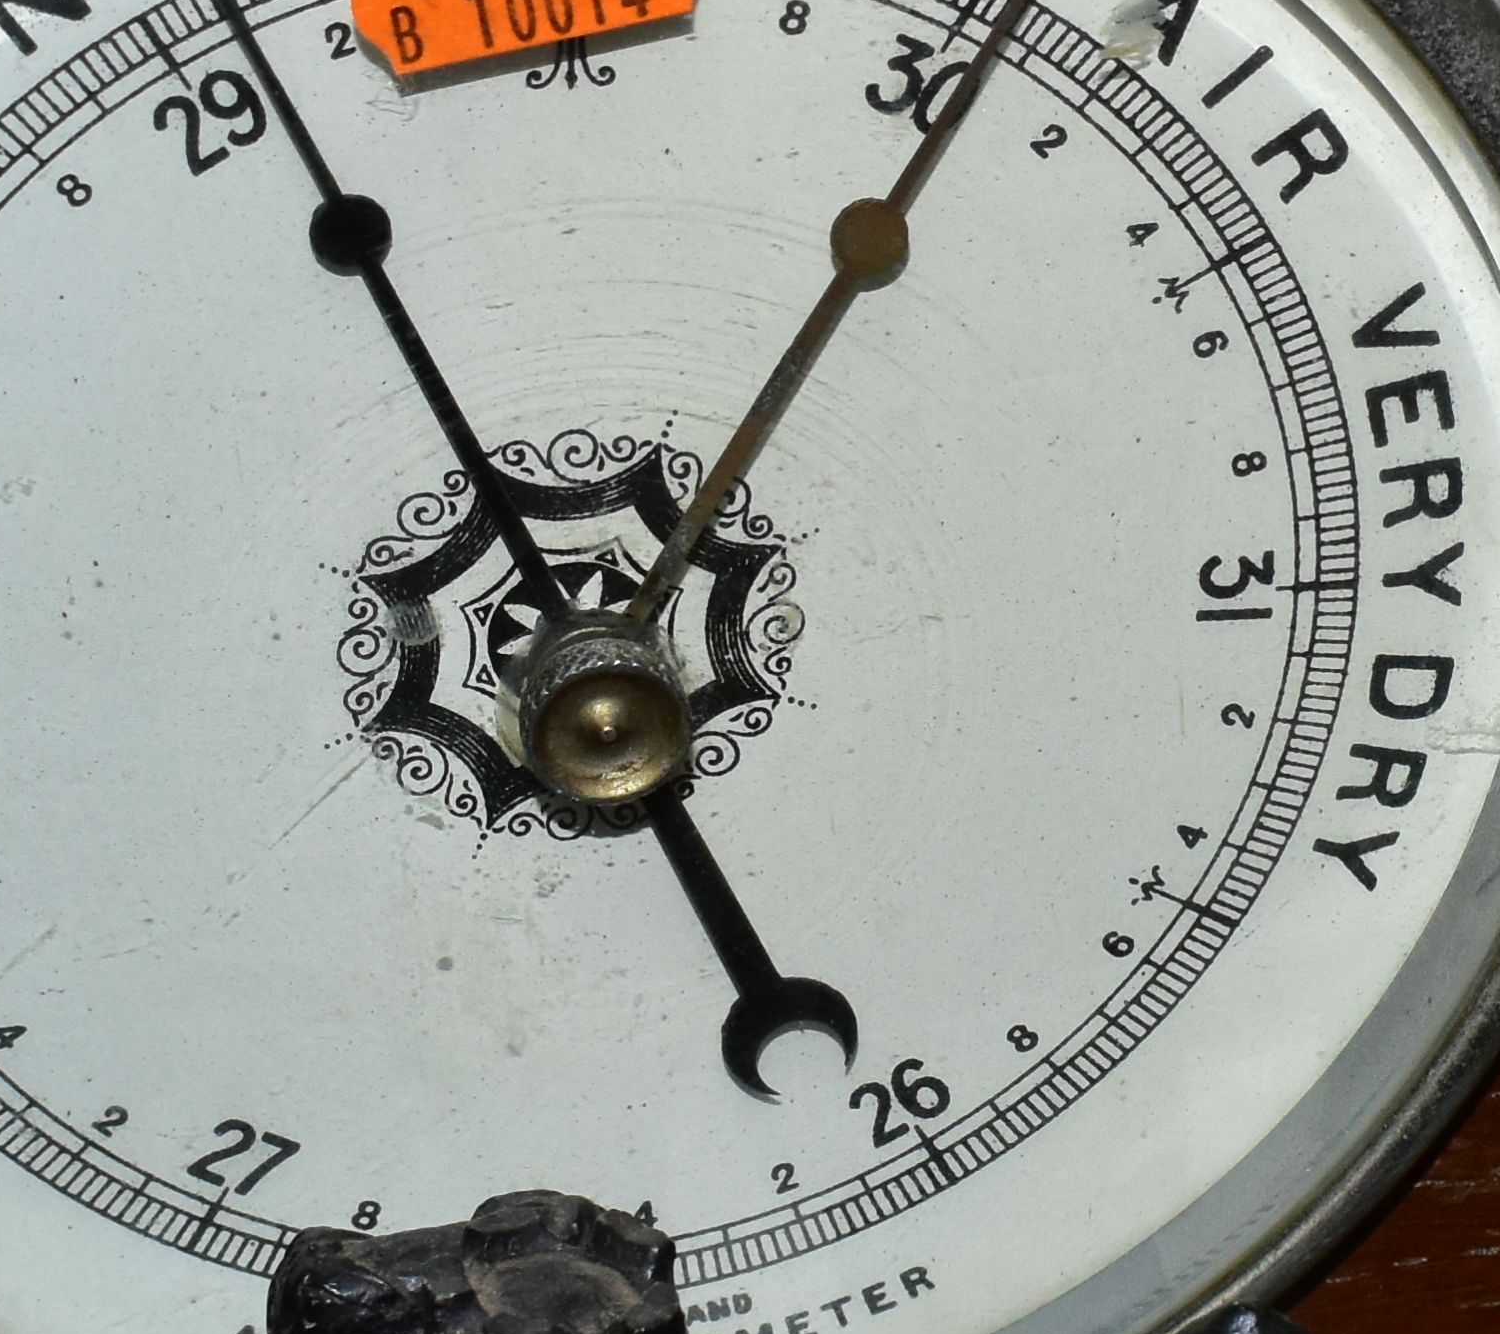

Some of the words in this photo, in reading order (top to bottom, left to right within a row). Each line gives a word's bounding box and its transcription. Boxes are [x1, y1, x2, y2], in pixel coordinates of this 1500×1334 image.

[779, 0, 810, 35] 8
[325, 22, 356, 59] 2
[389, 5, 425, 64] B
[865, 34, 980, 134] 30
[154, 70, 267, 176] 29
[1030, 124, 1067, 159] 2
[57, 174, 92, 206] 8
[1126, 223, 1158, 247] 4
[1193, 331, 1229, 358] 6
[1352, 282, 1464, 606] VERY
[1232, 451, 1267, 477] 8
[1196, 551, 1275, 621] 31
[1221, 704, 1255, 729] 2
[1313, 654, 1454, 891] DRY
[1177, 825, 1207, 849] 4
[1102, 931, 1134, 957] 6
[1007, 1025, 1038, 1052] 8
[849, 1059, 950, 1148] 26
[92, 1106, 128, 1137] 2
[187, 1119, 300, 1195] 27
[772, 1163, 799, 1194] 2
[352, 1201, 381, 1230] 8
[634, 1200, 657, 1227] 4
[686, 1293, 752, 1326] AND
